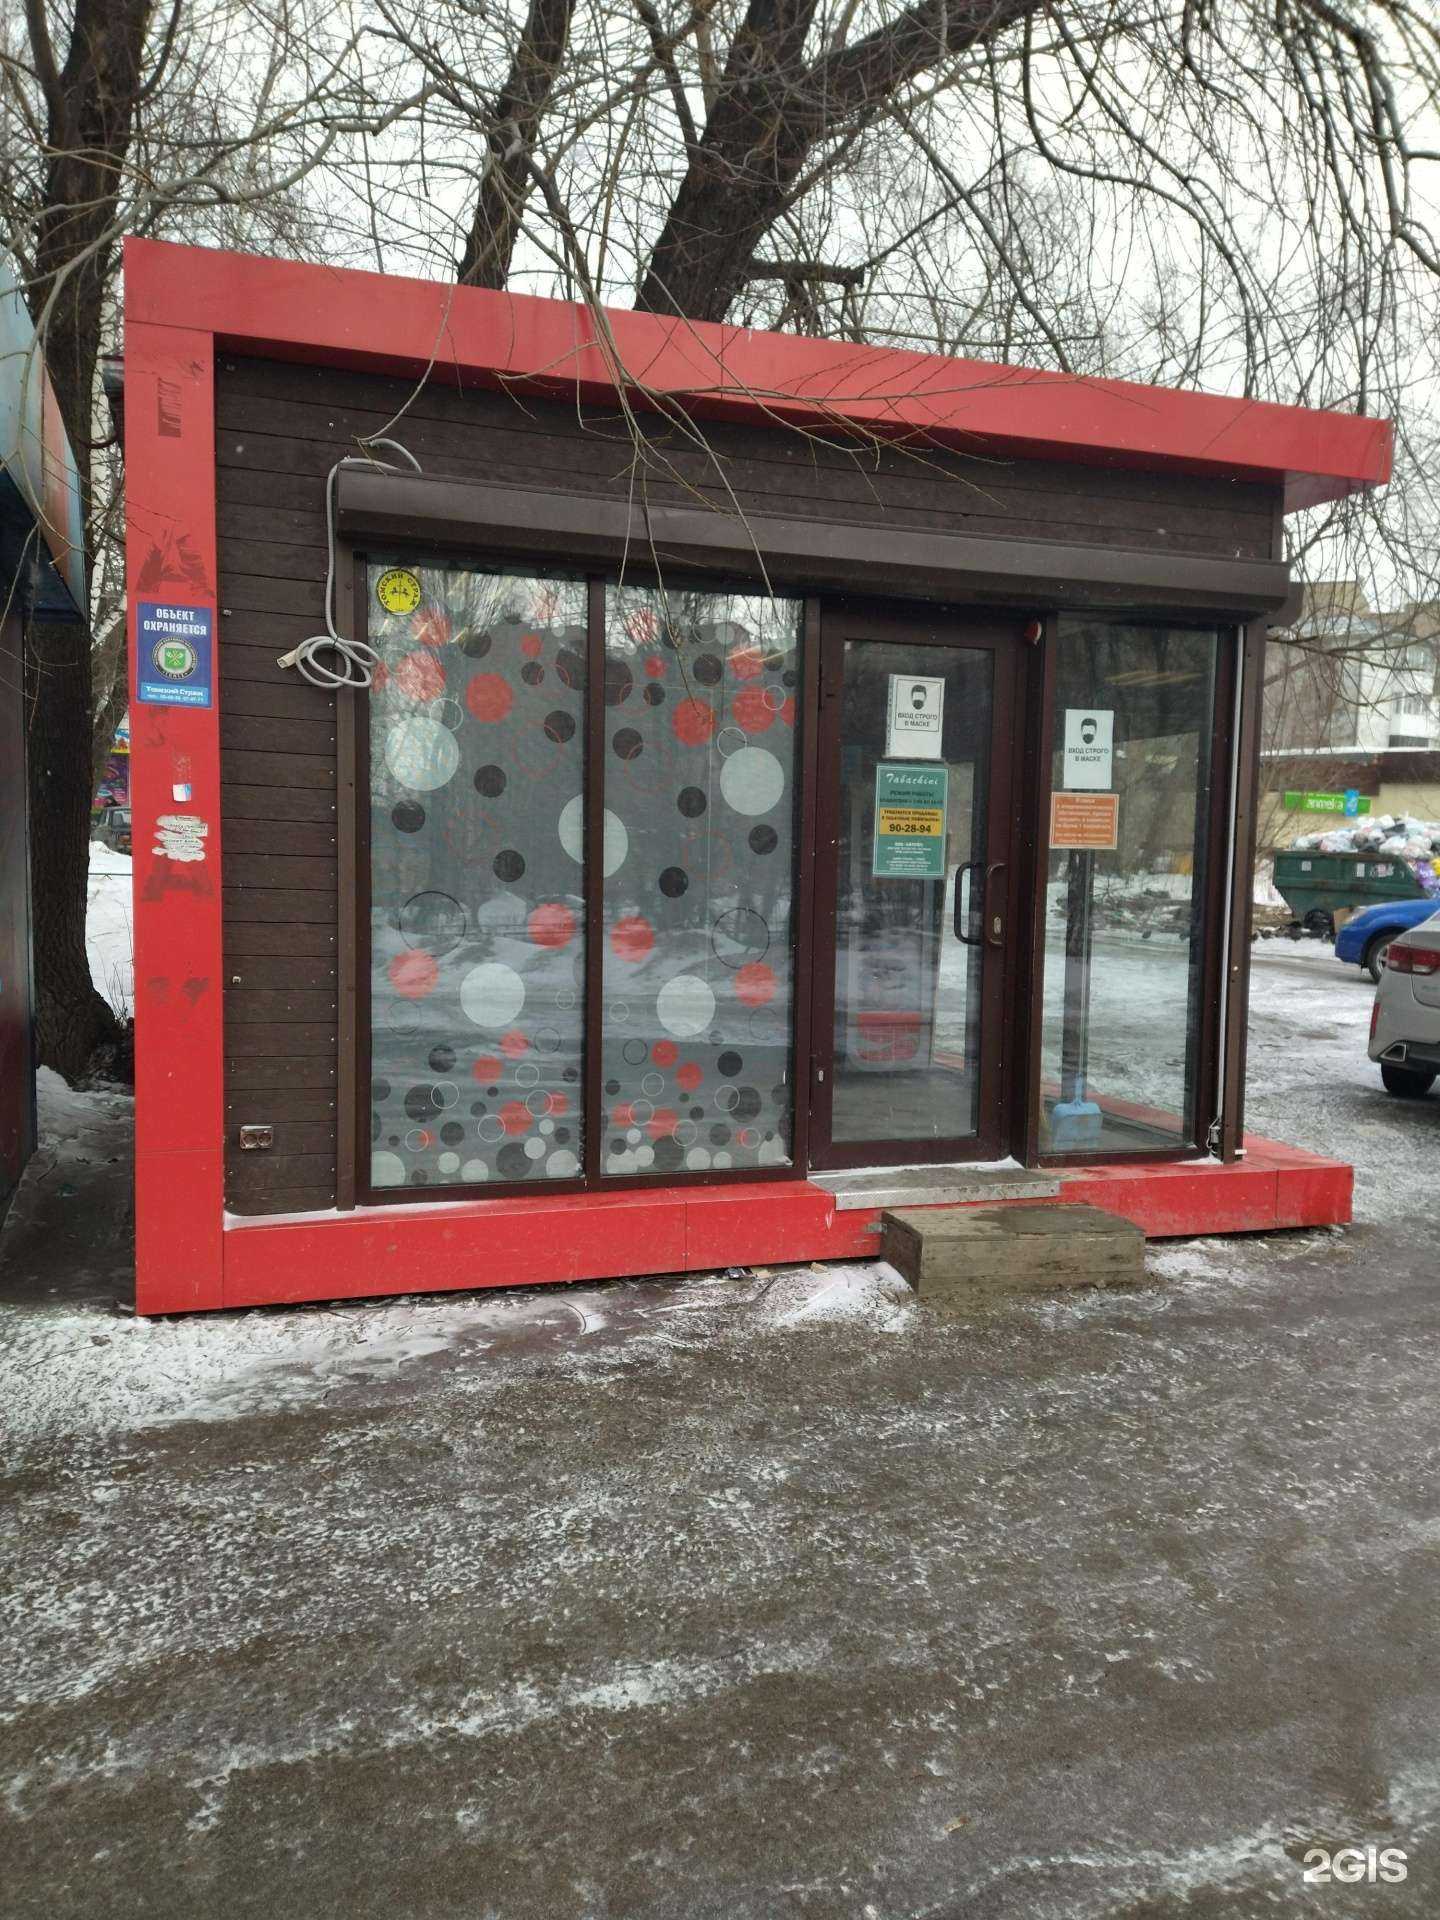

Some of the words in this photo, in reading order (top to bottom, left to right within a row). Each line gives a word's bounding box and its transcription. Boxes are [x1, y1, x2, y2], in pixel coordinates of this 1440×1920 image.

[380, 573, 404, 606] ТОМСКИЙ
[156, 608, 195, 621] ОБЪЕКТ
[143, 620, 207, 635] ОХРАНЯЕТСЯ
[897, 712, 913, 720] ВХОД
[889, 823, 932, 833] 90-28-94
